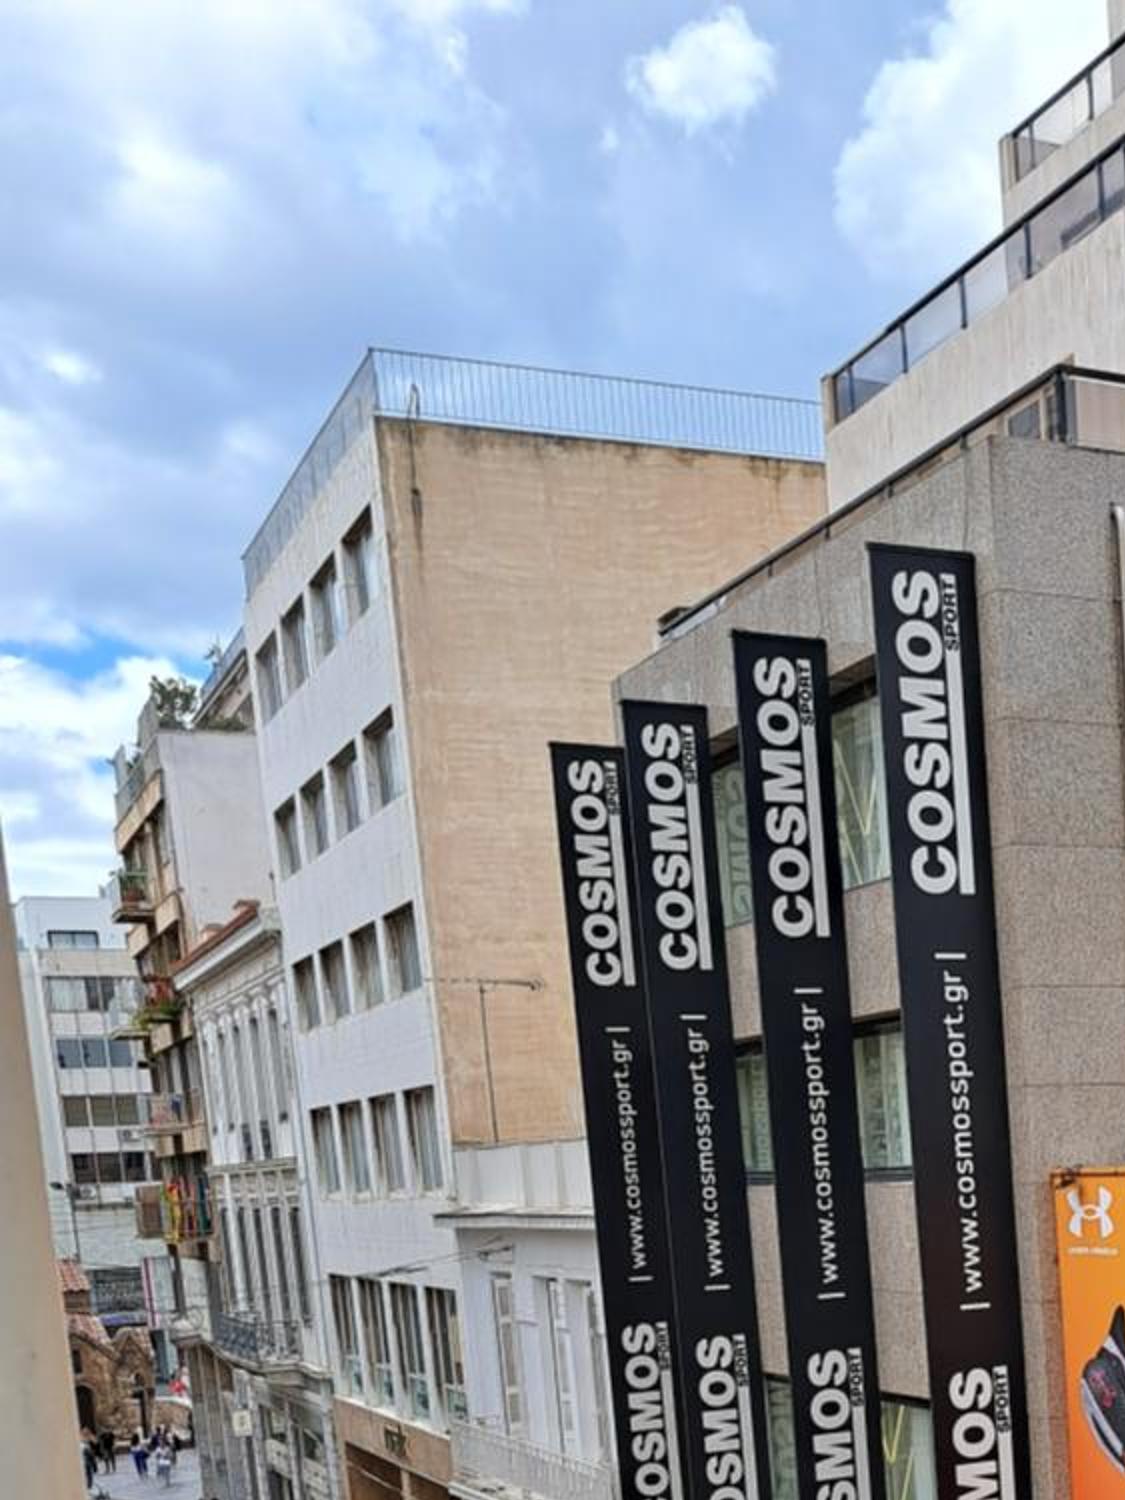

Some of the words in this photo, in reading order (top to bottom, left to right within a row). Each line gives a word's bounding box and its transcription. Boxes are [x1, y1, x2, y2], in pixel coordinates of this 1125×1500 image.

[798, 660, 817, 728] SPORT
[941, 574, 961, 652] SPORT
[642, 722, 697, 971] COSMOS
[683, 726, 698, 785] SPORT
[753, 656, 814, 937] COSMOS
[891, 570, 958, 895] COSMOS
[568, 758, 622, 987] COSMOS
[611, 1040, 648, 1269] www.cosmossport.gr
[688, 1028, 726, 1277] www.cosmossport.gr
[802, 1004, 840, 1284] www.cosmossport.gr
[943, 970, 985, 1293] www.cosmossport.gr
[732, 1334, 748, 1387] SPORT
[847, 1347, 862, 1408] SPORT
[992, 1365, 1010, 1435] SPORT
